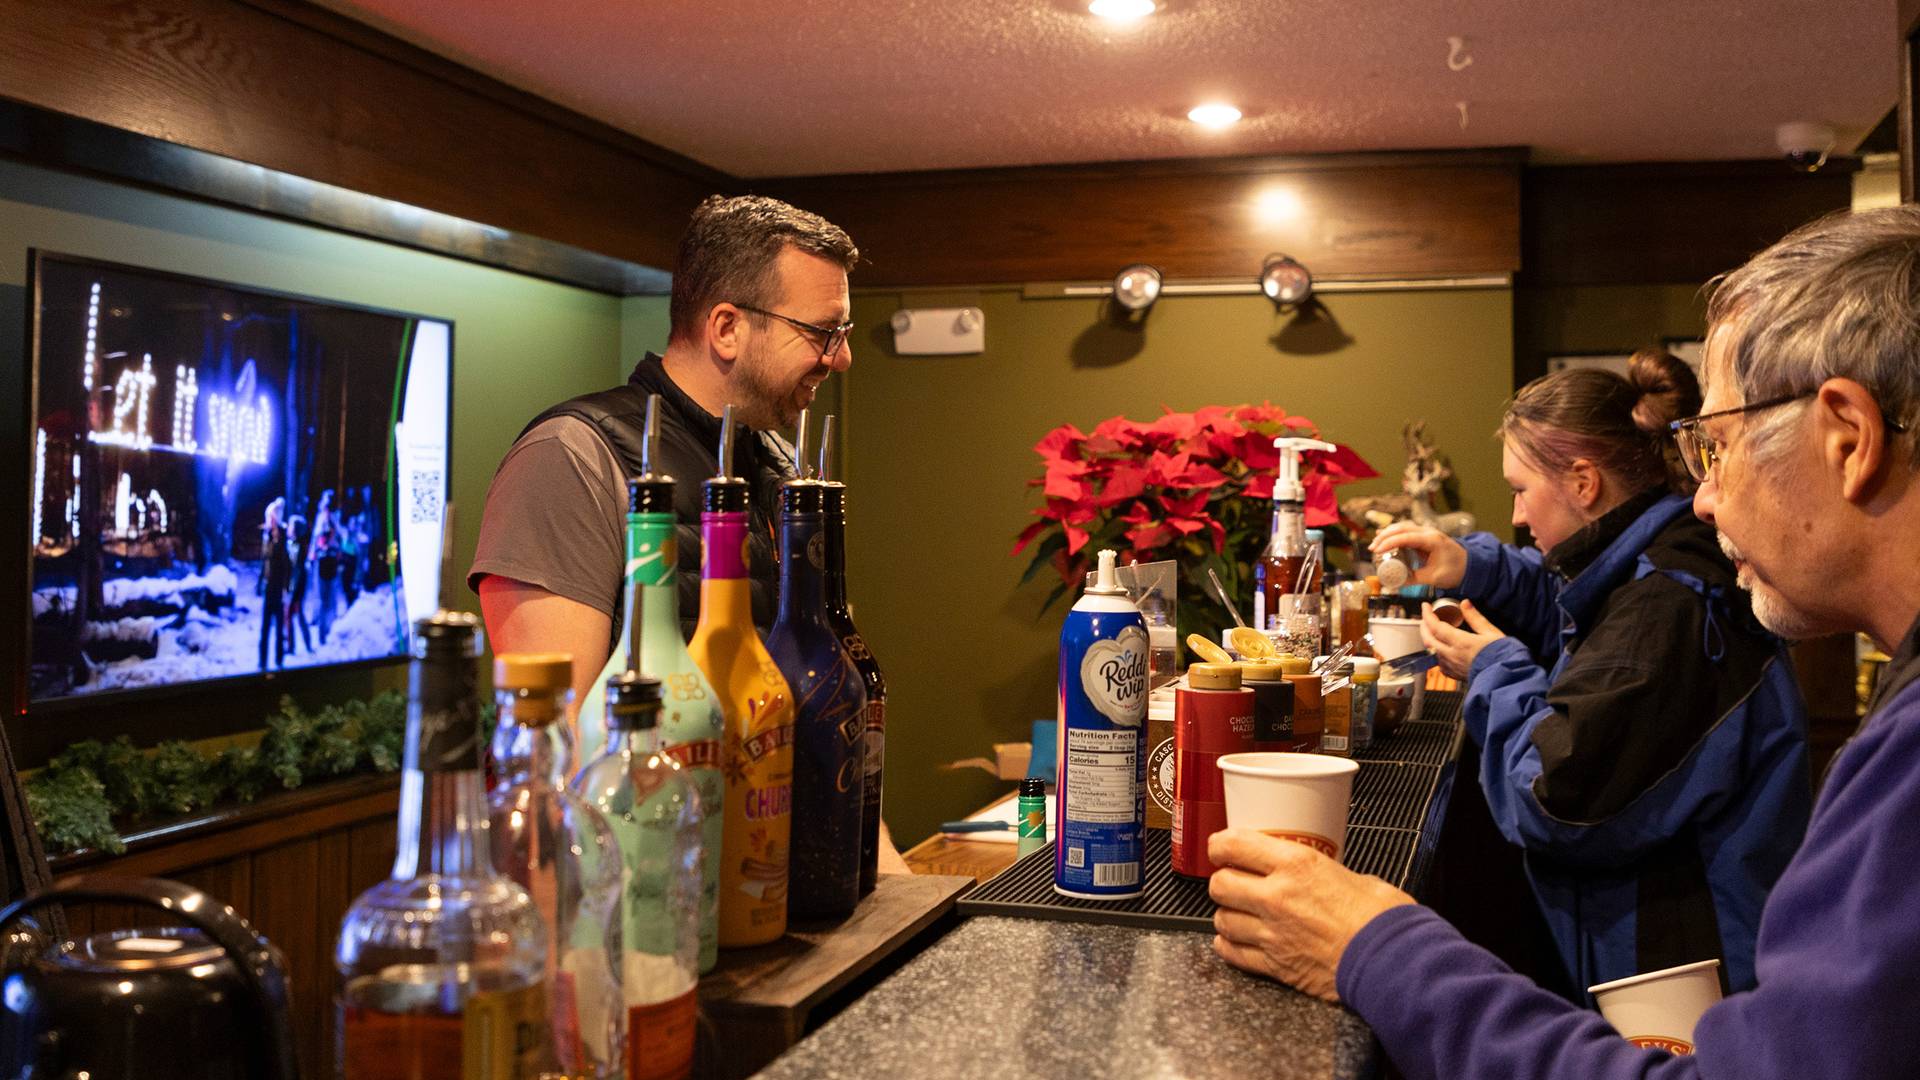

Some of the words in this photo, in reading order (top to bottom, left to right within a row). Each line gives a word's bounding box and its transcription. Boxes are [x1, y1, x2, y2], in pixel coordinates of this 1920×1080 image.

[1117, 679, 1144, 701] wip
[1271, 722, 1292, 731] CHOC
[1069, 730, 1109, 740] Nutrition
[1112, 732, 1136, 740] Facts
[1069, 754, 1099, 765] Calories
[1125, 755, 1136, 764] 15
[1154, 743, 1174, 763] CASC
[745, 784, 792, 819] CHUR
[1156, 791, 1174, 808] DIST
